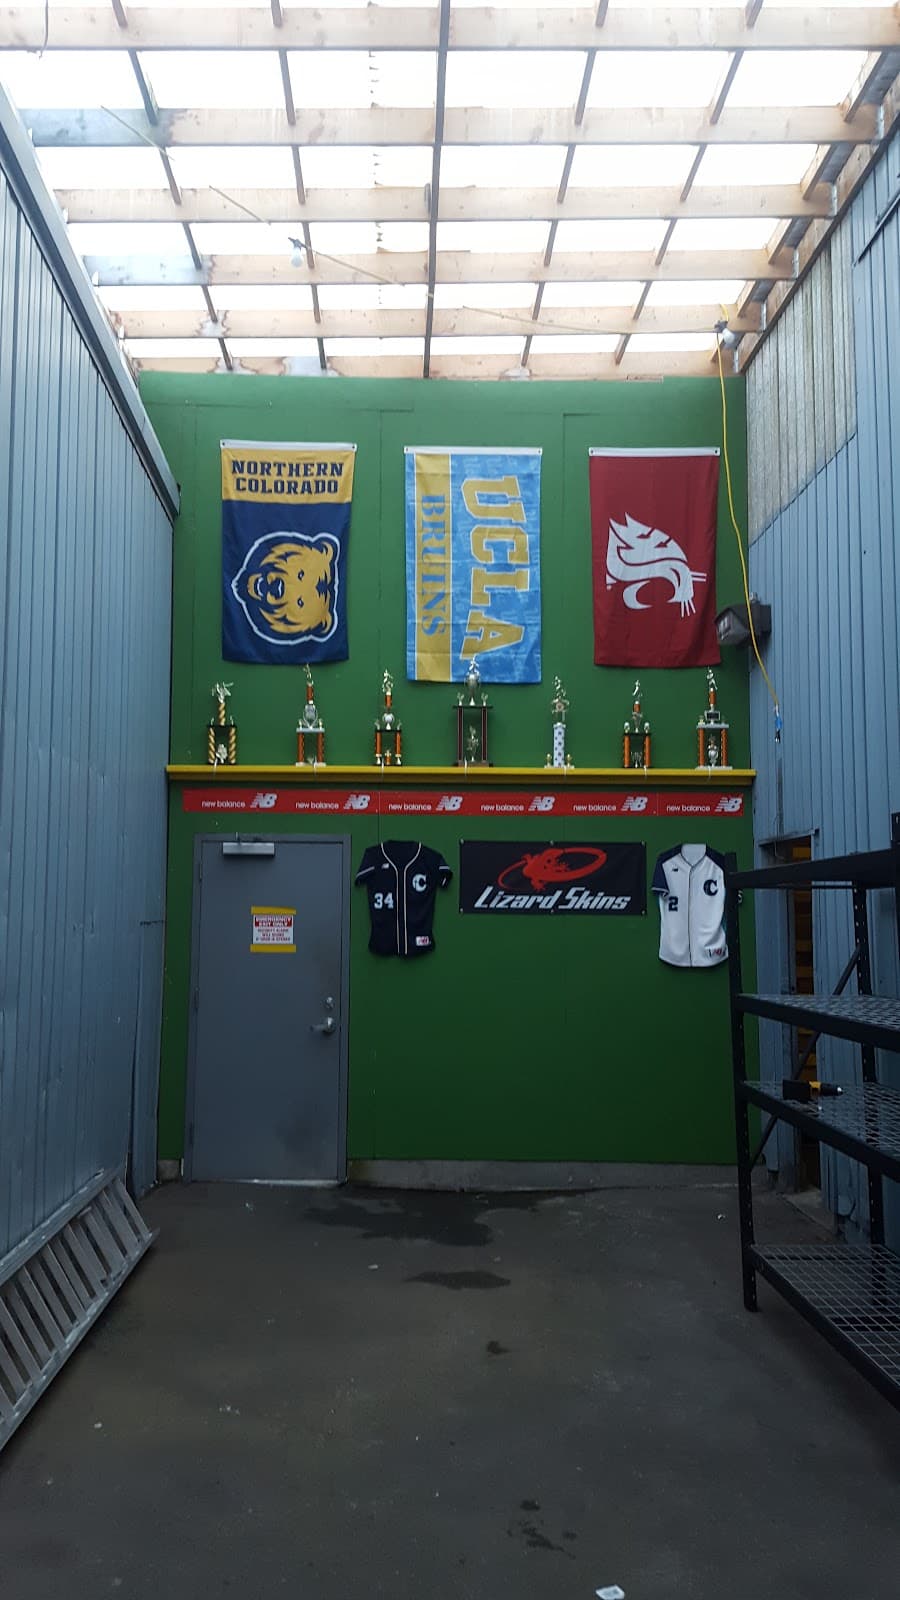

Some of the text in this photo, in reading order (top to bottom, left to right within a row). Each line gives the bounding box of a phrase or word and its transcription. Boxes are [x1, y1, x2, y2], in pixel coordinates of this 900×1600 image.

[231, 459, 344, 477] NORTHERN
[235, 477, 339, 495] COLORADO
[421, 495, 446, 636] BRUINS
[459, 475, 530, 660] UCLA
[216, 800, 246, 809] balance
[250, 793, 278, 809] NB
[310, 801, 339, 810] balance
[343, 793, 371, 810] NB
[403, 802, 432, 811] balance
[436, 795, 463, 811] NB
[495, 803, 524, 812] balance
[528, 796, 556, 812] NB
[588, 803, 617, 812] balance
[620, 796, 648, 812] NB
[681, 804, 711, 812] balance
[714, 797, 743, 812] NB
[374, 892, 394, 909] 34
[474, 886, 631, 910] Lizard Skins
[668, 896, 679, 912] 2
